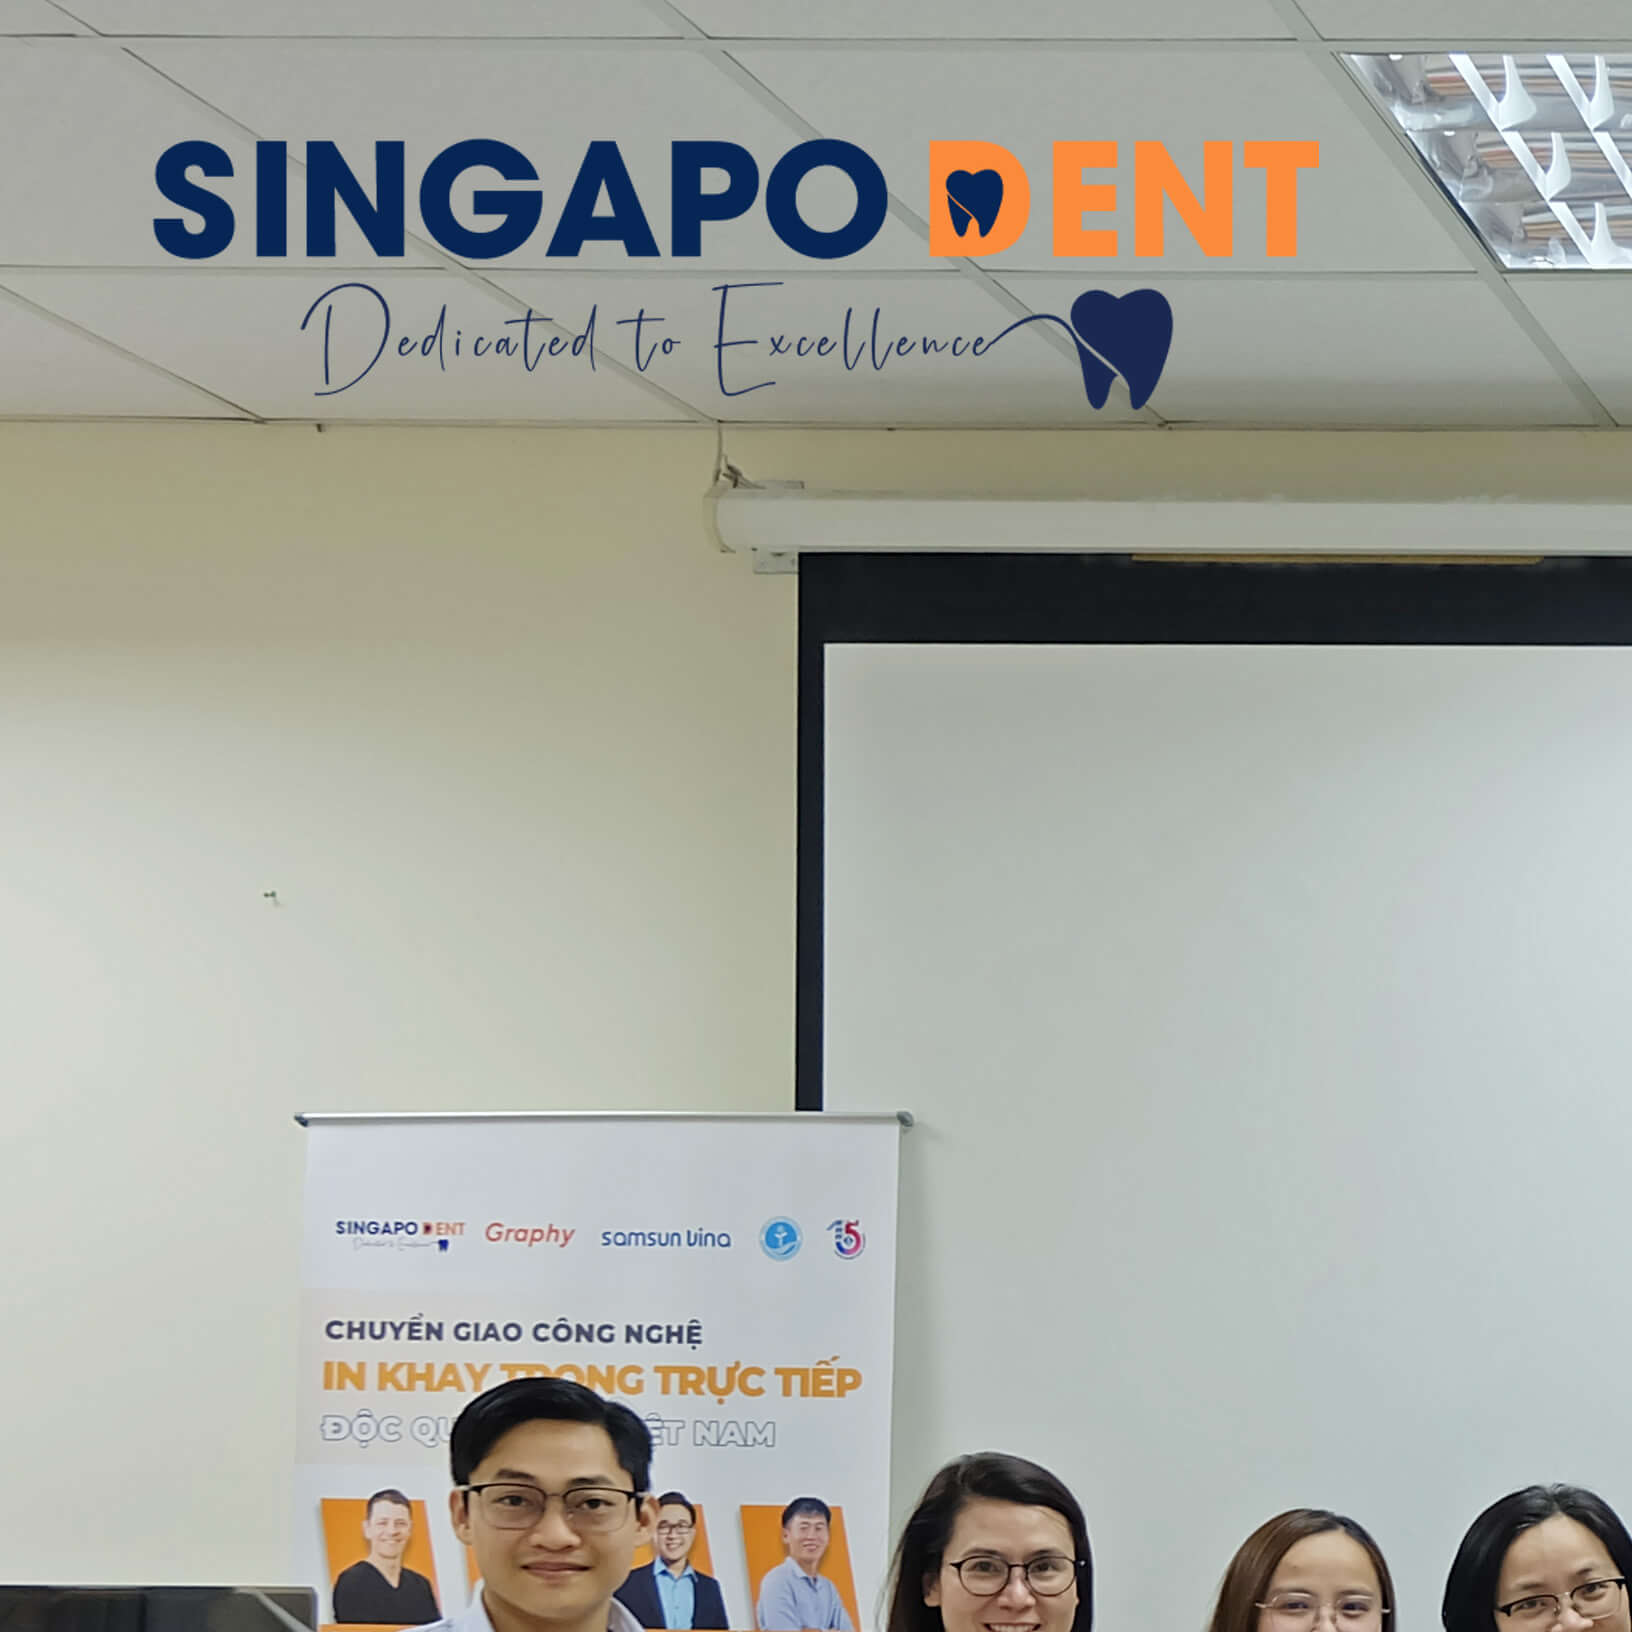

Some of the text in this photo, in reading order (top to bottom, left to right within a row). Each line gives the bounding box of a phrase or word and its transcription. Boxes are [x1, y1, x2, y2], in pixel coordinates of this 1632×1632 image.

[335, 1220, 466, 1236] SINGAPO DENT
[485, 1222, 576, 1248] Graphy
[601, 1231, 682, 1248] samsun
[325, 1312, 704, 1350] CHUYỂN GIAO CÔNG NGHỆ
[322, 1360, 367, 1391] IN
[377, 1362, 492, 1393] KHAY
[653, 1360, 766, 1405] TRỰC
[774, 1355, 863, 1399] TIẾP
[319, 1408, 402, 1448] ĐỘC
[693, 1420, 776, 1447] NAM
